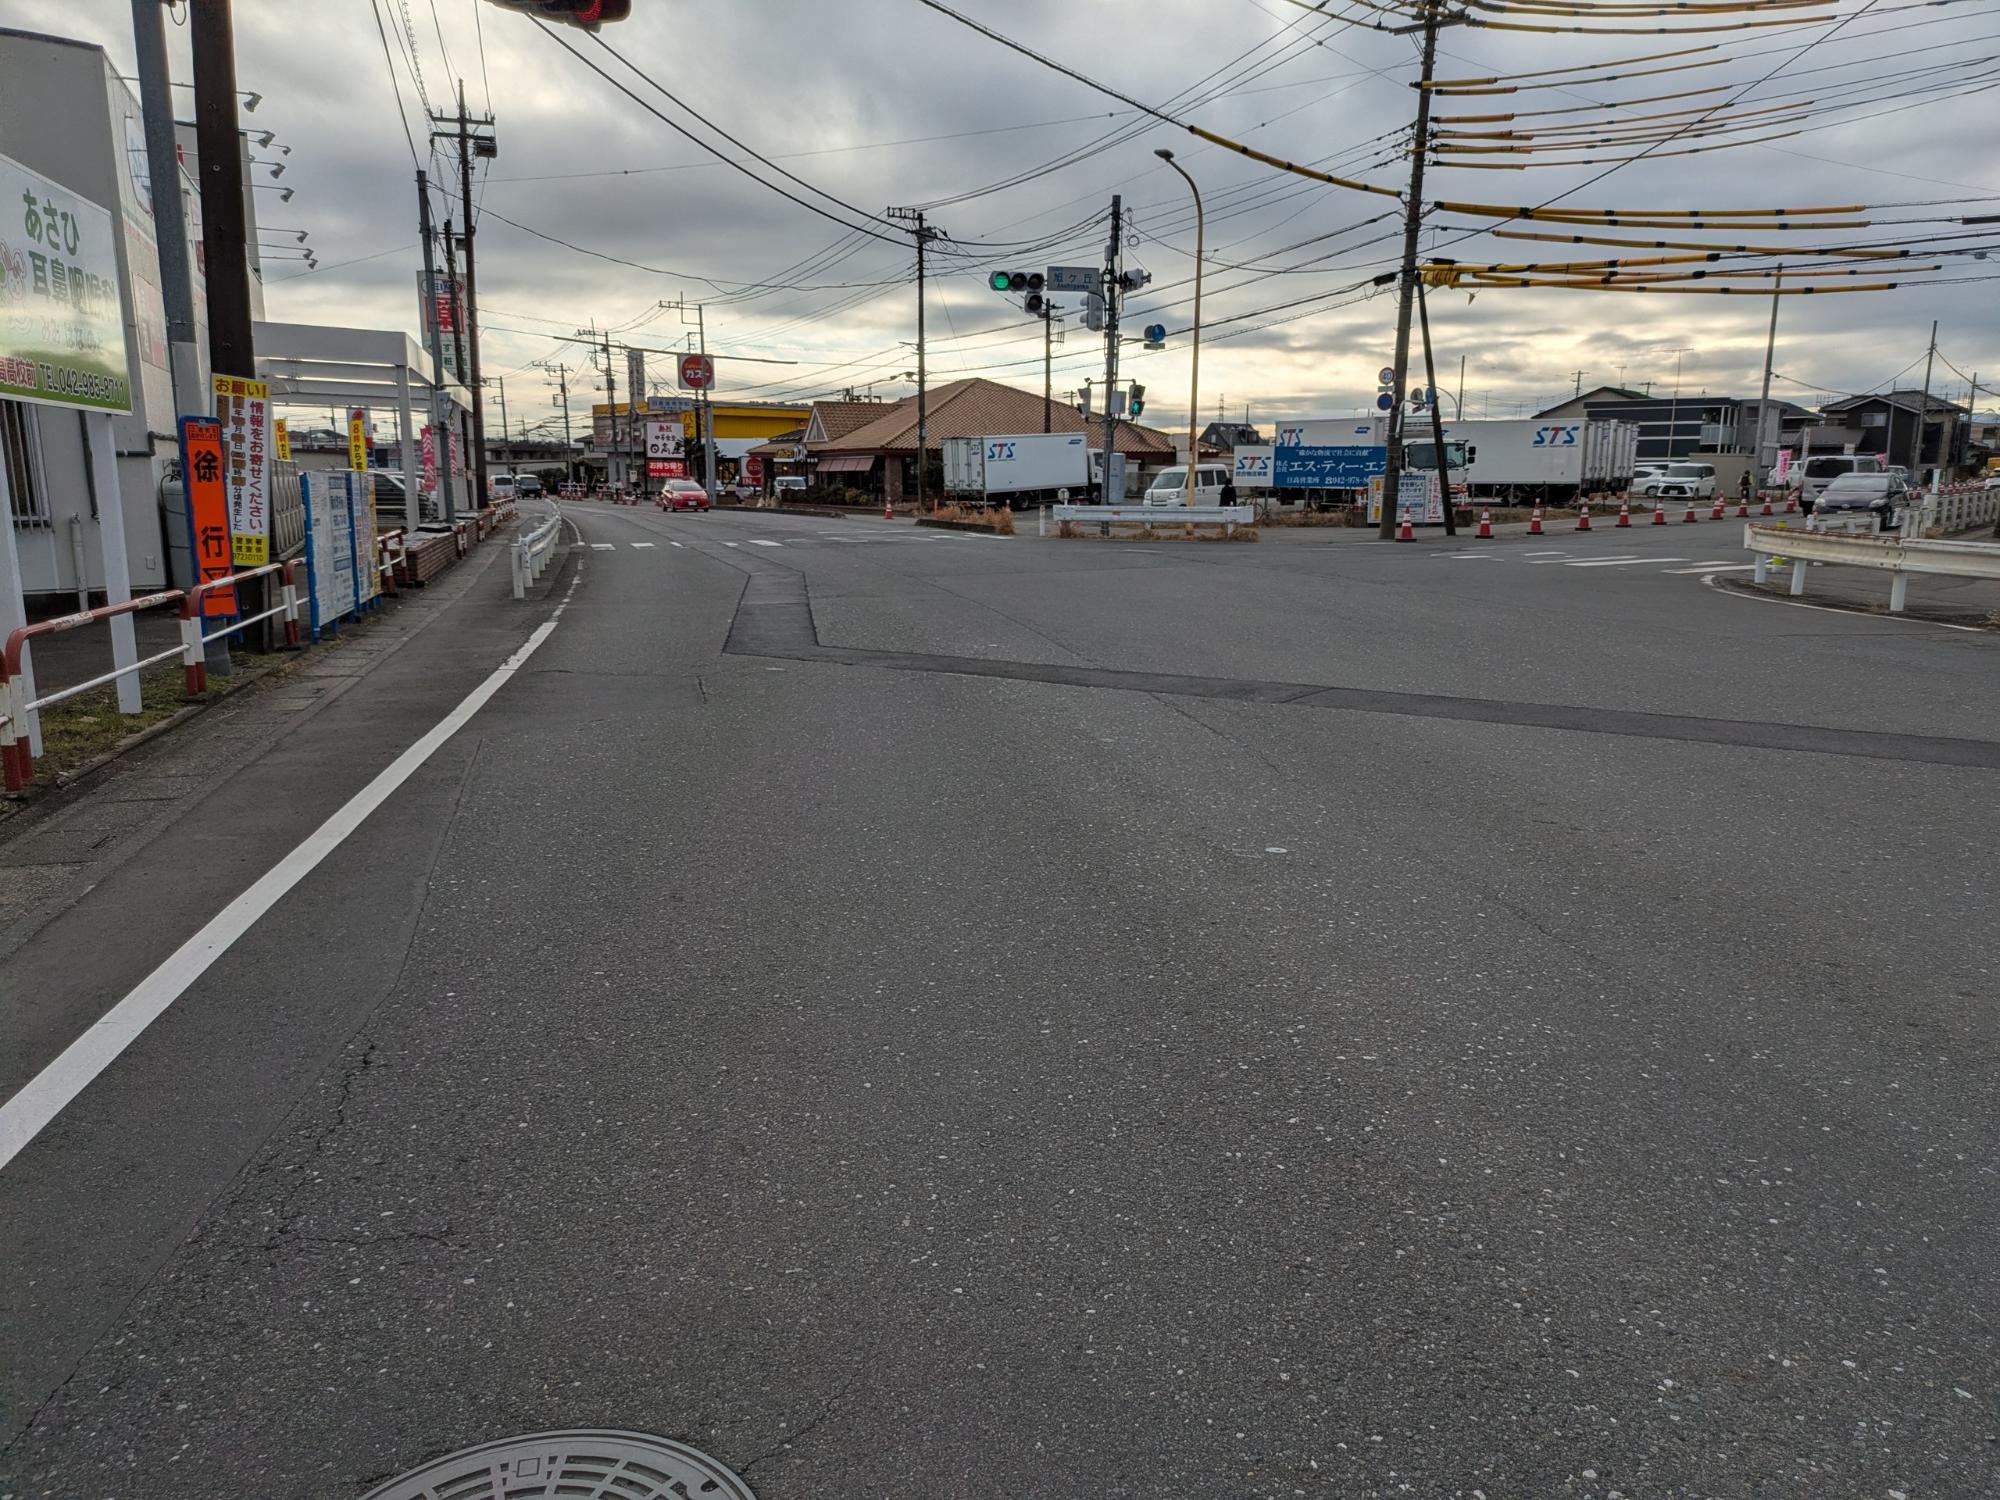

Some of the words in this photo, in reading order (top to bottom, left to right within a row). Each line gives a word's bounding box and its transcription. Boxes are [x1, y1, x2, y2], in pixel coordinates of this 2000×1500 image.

[23, 187, 80, 256] あさひ
[686, 369, 710, 379] ガス
[1279, 429, 1304, 446] STS
[1533, 426, 1581, 444] STS
[988, 442, 1016, 459] STS
[1236, 457, 1272, 470] STS
[193, 449, 224, 559] 徐行
